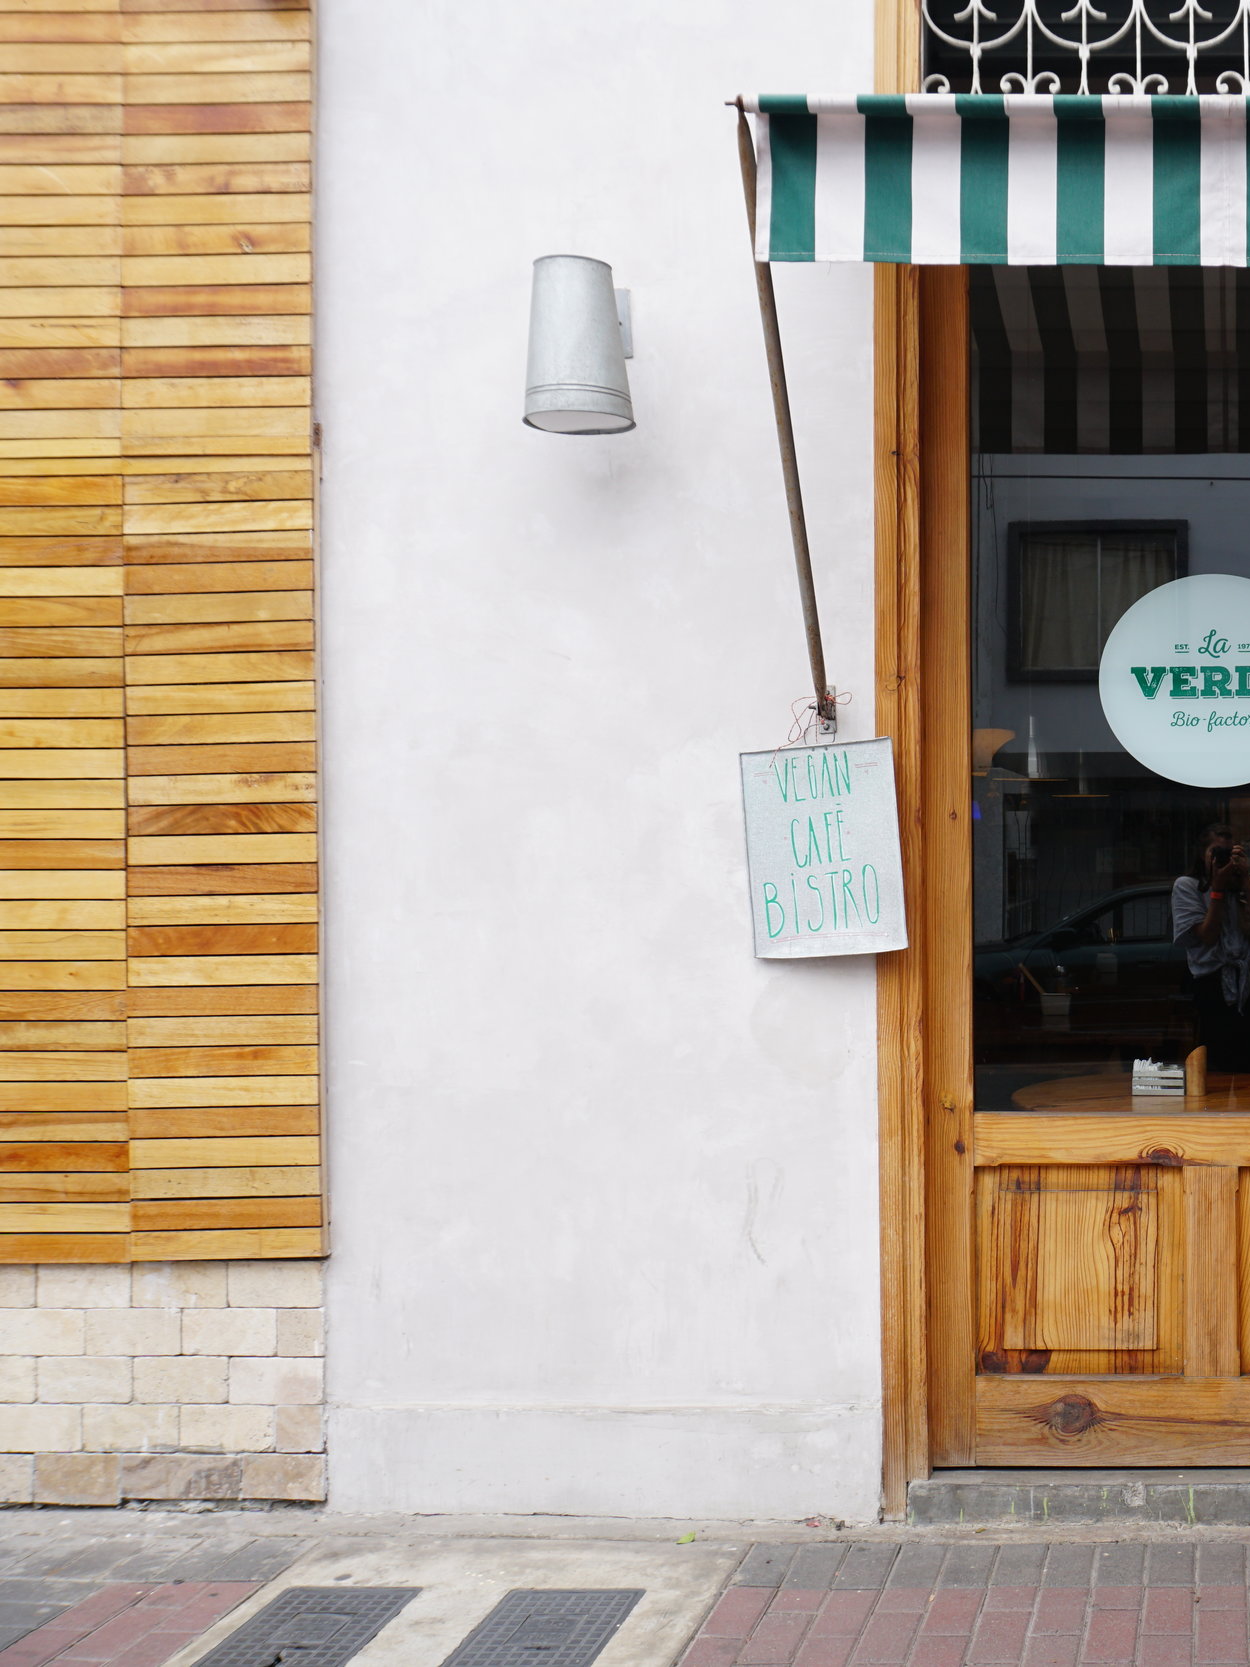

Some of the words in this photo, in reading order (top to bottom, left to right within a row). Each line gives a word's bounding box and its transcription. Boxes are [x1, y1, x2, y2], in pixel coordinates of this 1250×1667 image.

[1197, 629, 1231, 658] La
[773, 750, 851, 802] VEGAN
[790, 803, 851, 868] CAFÉ
